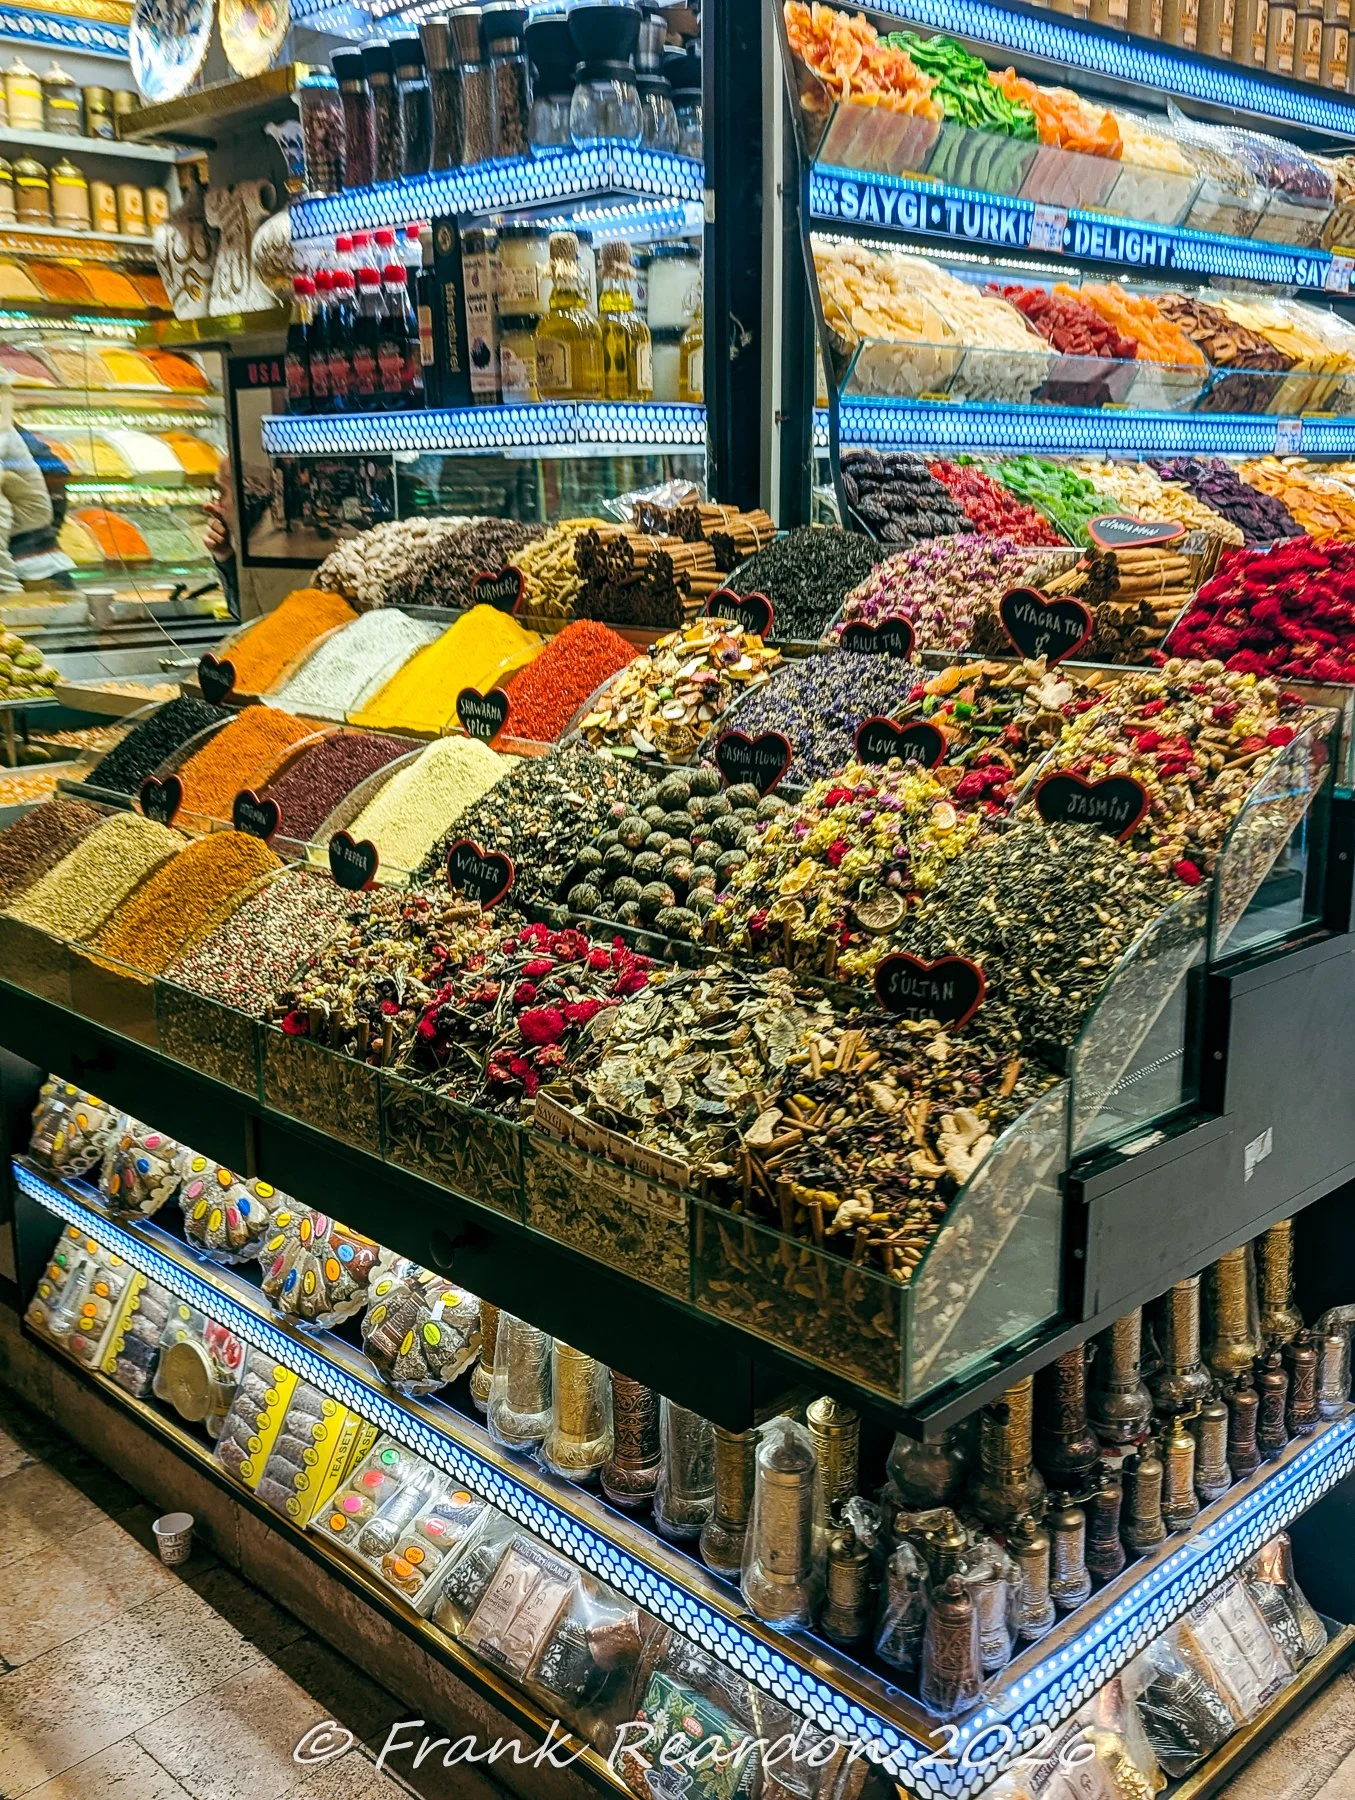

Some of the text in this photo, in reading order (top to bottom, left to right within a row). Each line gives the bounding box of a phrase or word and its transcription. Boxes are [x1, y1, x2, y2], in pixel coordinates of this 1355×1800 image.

[840, 182, 927, 229] SAYGI
[945, 199, 1034, 246] TURKI
[1074, 221, 1172, 267] DELIGHT
[1296, 259, 1332, 288] SAY
[248, 362, 281, 383] USA
[717, 603, 754, 630] ENERGY
[1064, 618, 1084, 639] TEA
[882, 632, 902, 650] TEA
[460, 698, 502, 722] SHAWARMA
[867, 734, 926, 762] LOVE TEA
[740, 770, 763, 788] TEA
[343, 847, 368, 872] PEPPER
[463, 878, 481, 900] TEA
[536, 1103, 562, 1129] SAYGI
[736, 1750, 758, 1792] TURKISH
